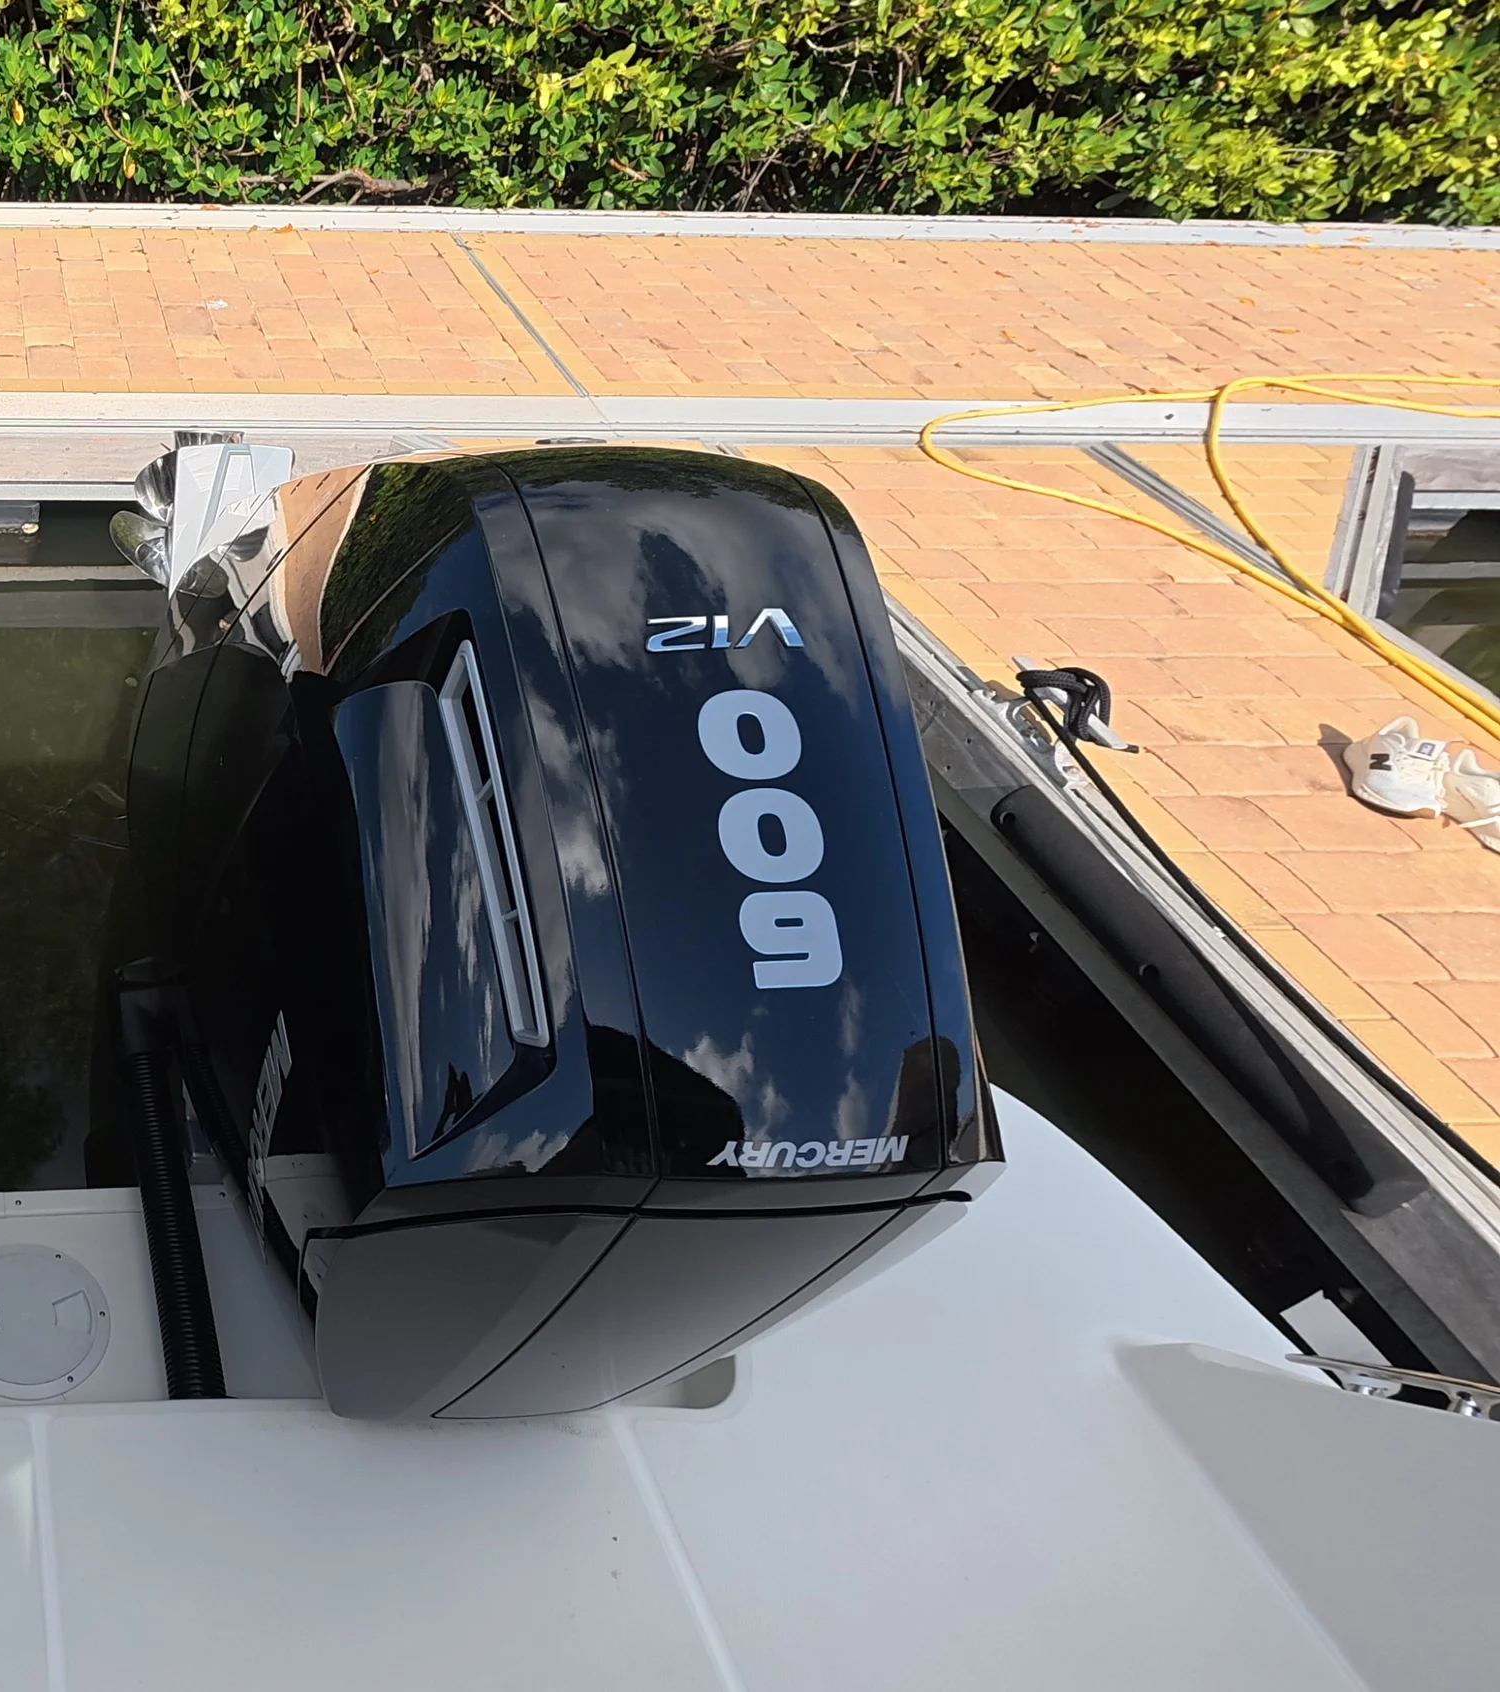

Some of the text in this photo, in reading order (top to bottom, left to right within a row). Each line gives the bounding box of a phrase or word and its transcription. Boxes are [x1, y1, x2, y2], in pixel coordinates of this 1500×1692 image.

[644, 607, 804, 653] V12
[1369, 753, 1392, 771] N
[697, 689, 843, 989] 600
[706, 1135, 909, 1168] MERCURY
